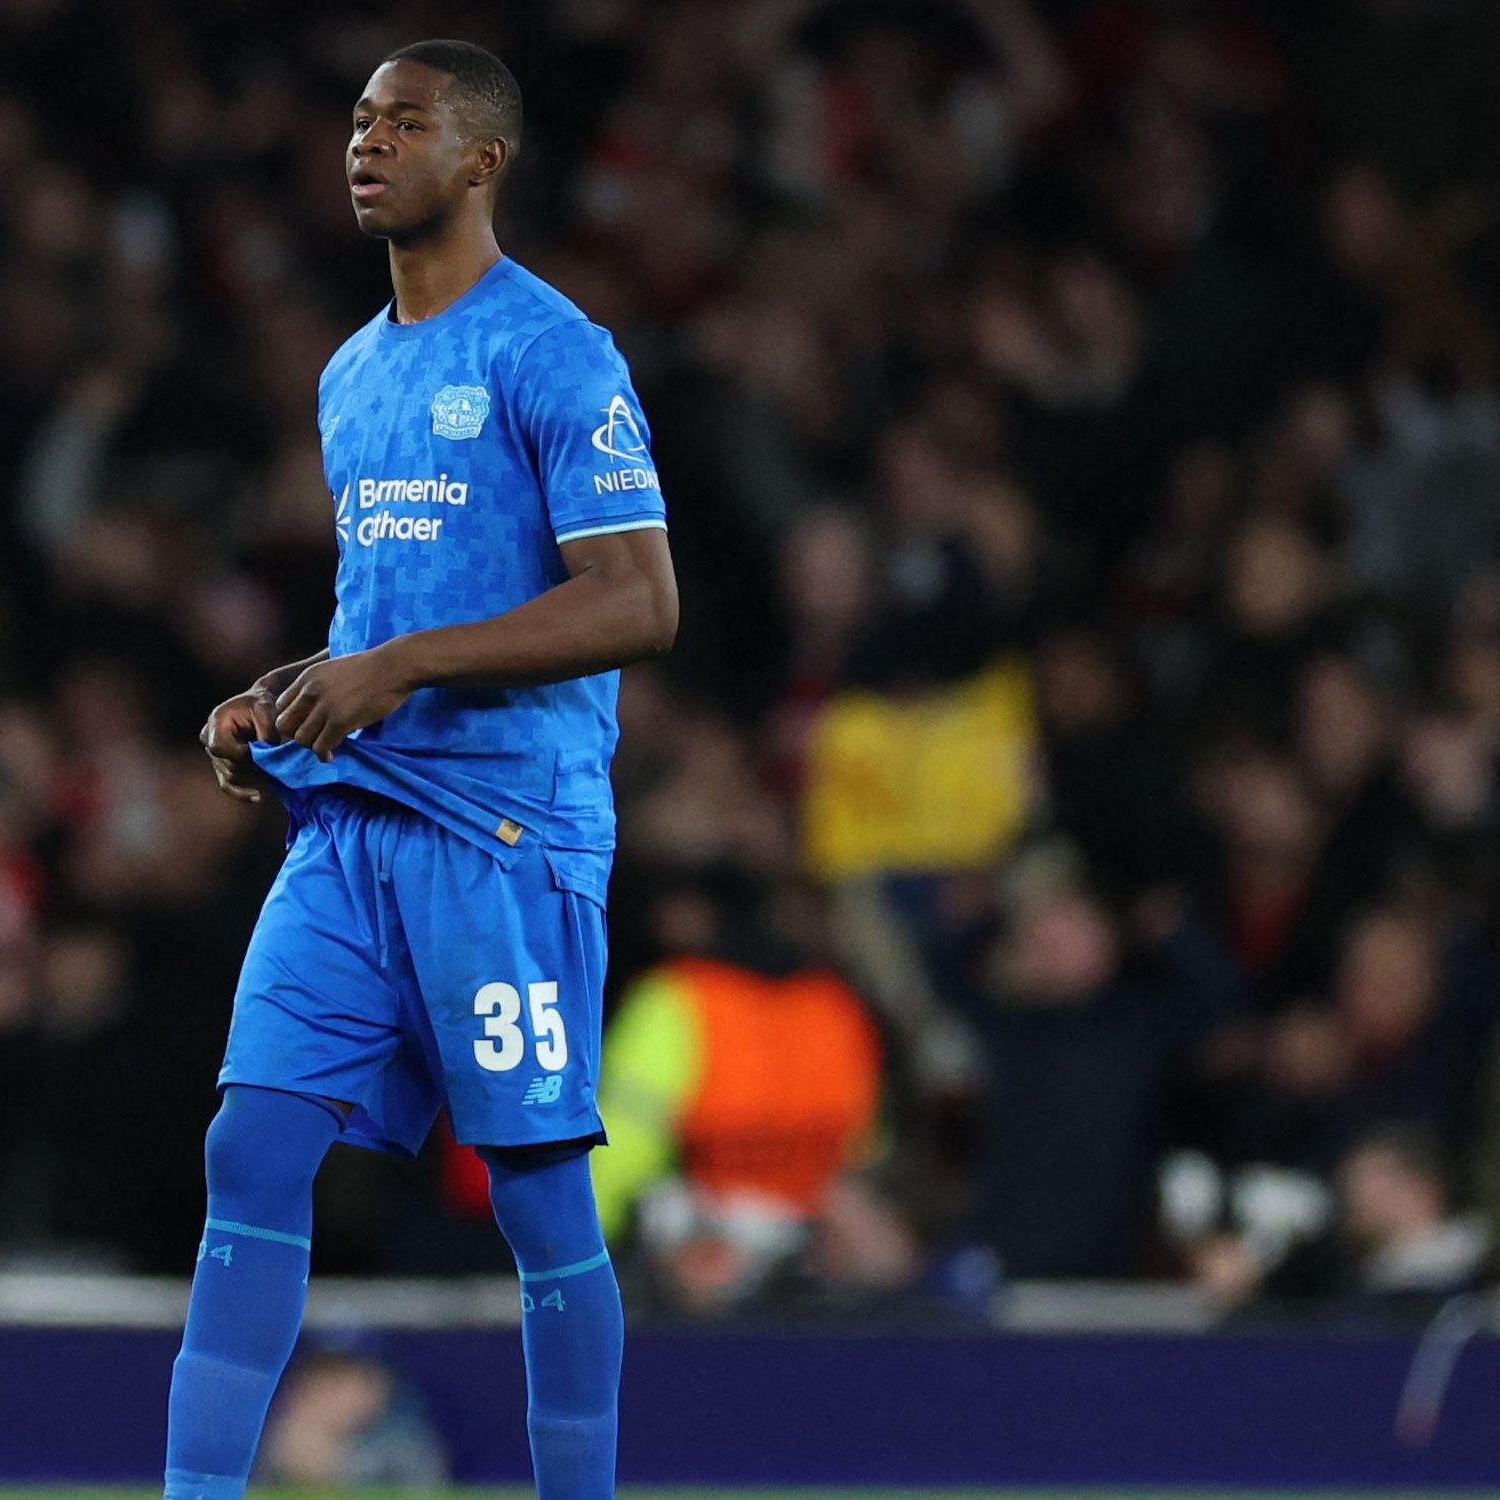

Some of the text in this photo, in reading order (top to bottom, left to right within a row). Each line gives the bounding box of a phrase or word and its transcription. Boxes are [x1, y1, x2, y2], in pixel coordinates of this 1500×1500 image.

[358, 473, 469, 509] Brmenia
[356, 510, 443, 547] Gthaer
[473, 980, 568, 1072] 35
